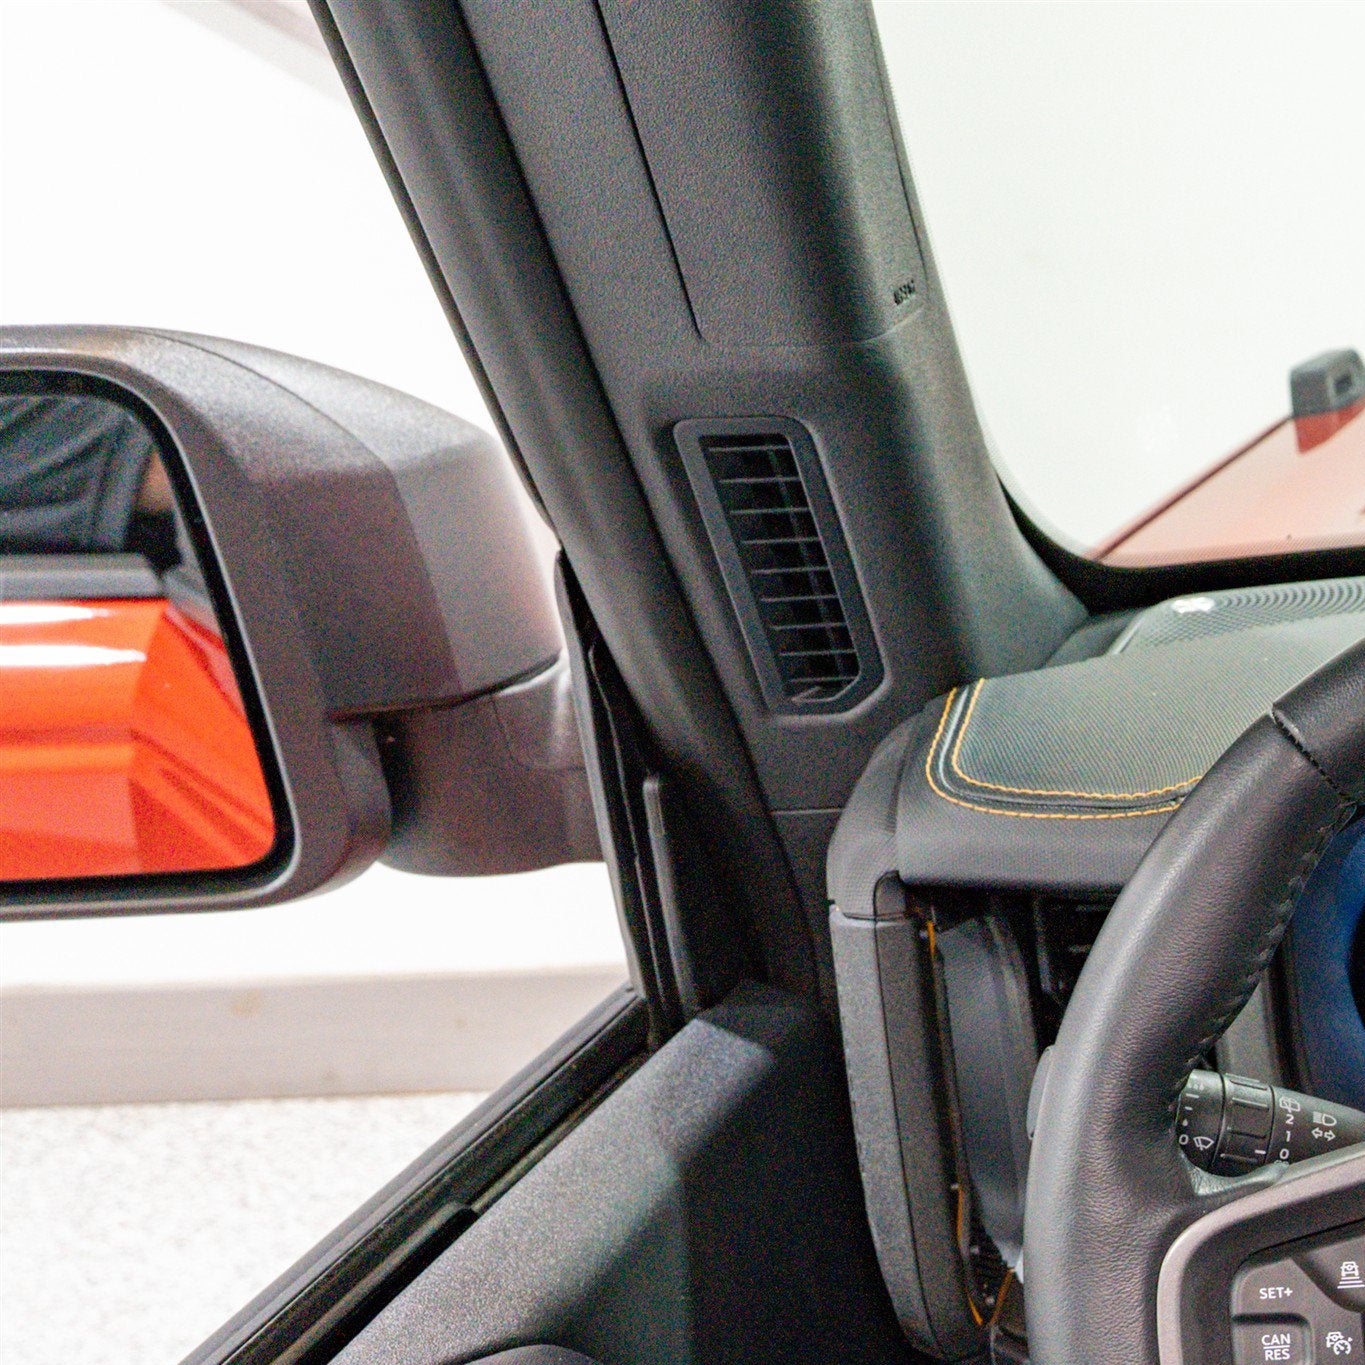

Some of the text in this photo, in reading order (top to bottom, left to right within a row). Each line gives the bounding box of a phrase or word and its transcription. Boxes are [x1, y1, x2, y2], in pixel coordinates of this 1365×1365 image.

[1285, 1113, 1295, 1125] 2
[1259, 1286, 1293, 1300] SET+
[1261, 1333, 1291, 1346] CAN
[1264, 1348, 1291, 1361] RES
